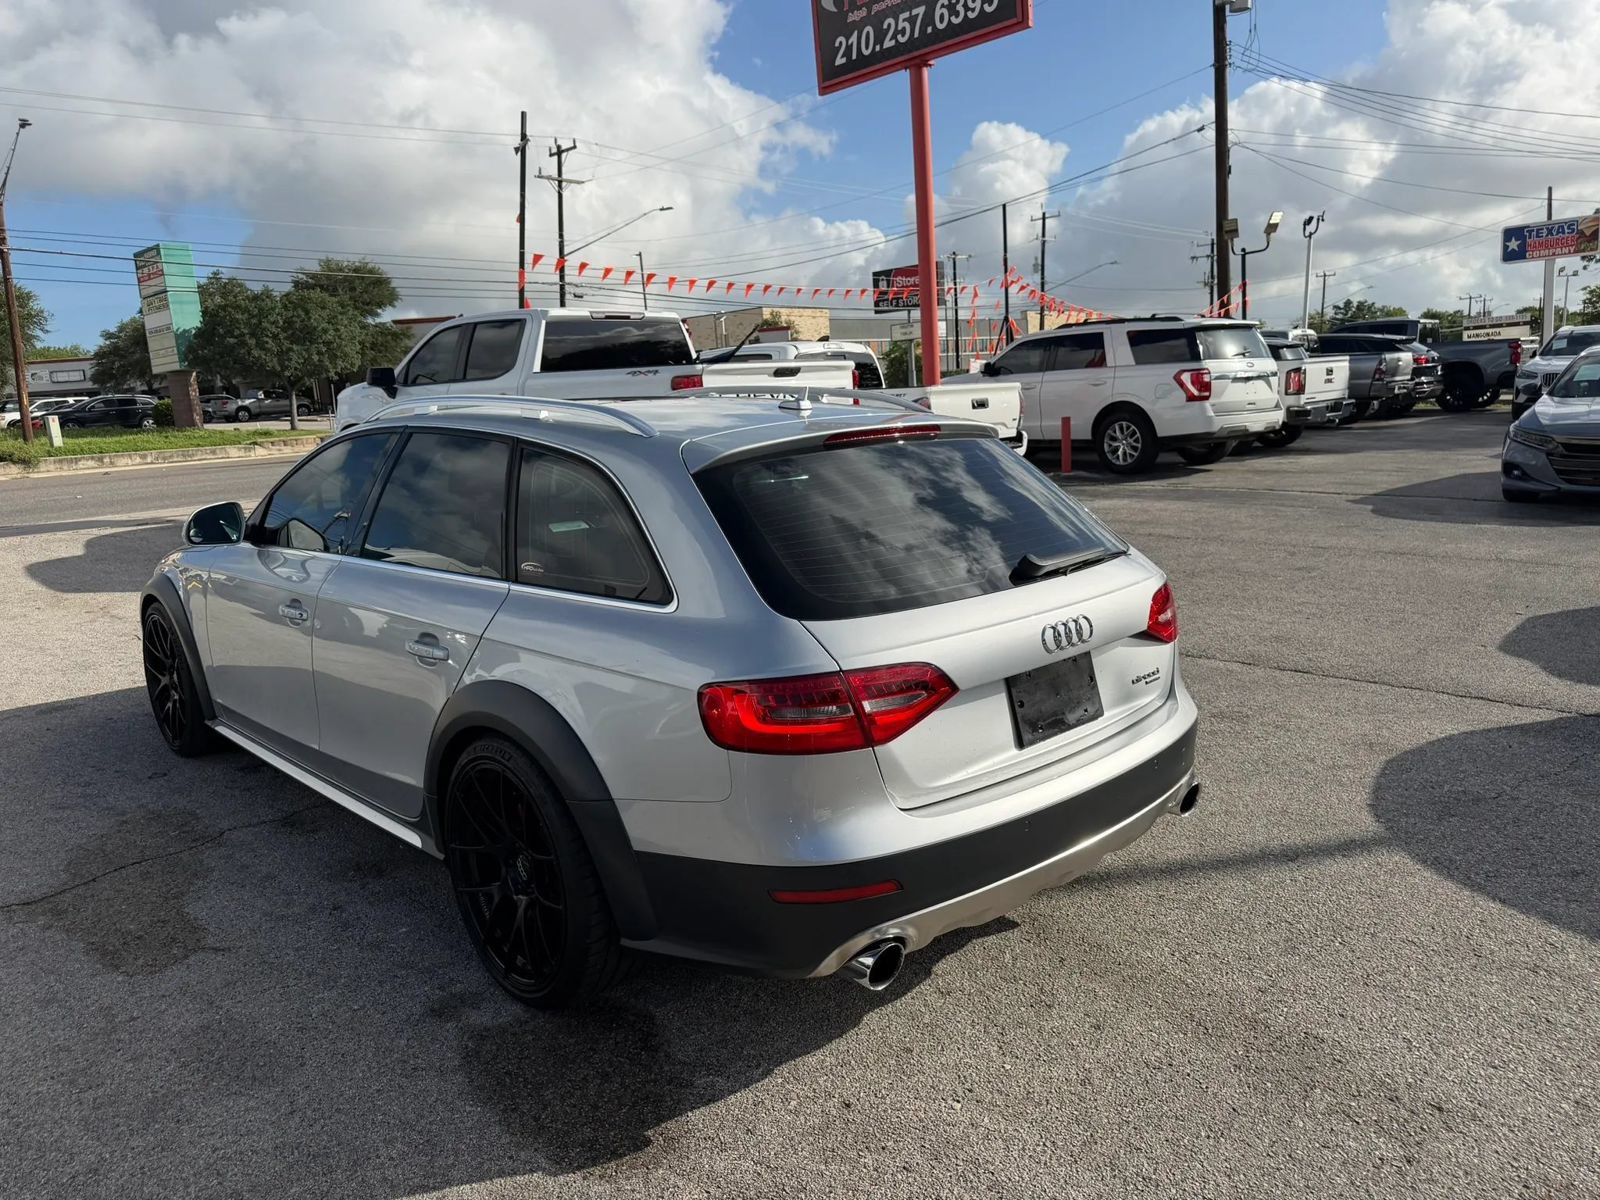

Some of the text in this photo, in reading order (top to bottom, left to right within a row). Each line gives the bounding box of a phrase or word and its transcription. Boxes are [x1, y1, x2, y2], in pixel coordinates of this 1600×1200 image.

[1524, 221, 1577, 240] TEXAS
[1526, 235, 1577, 251] HAMBURGER
[1526, 246, 1576, 259] COMPANY
[1467, 331, 1501, 339] MANGONADA
